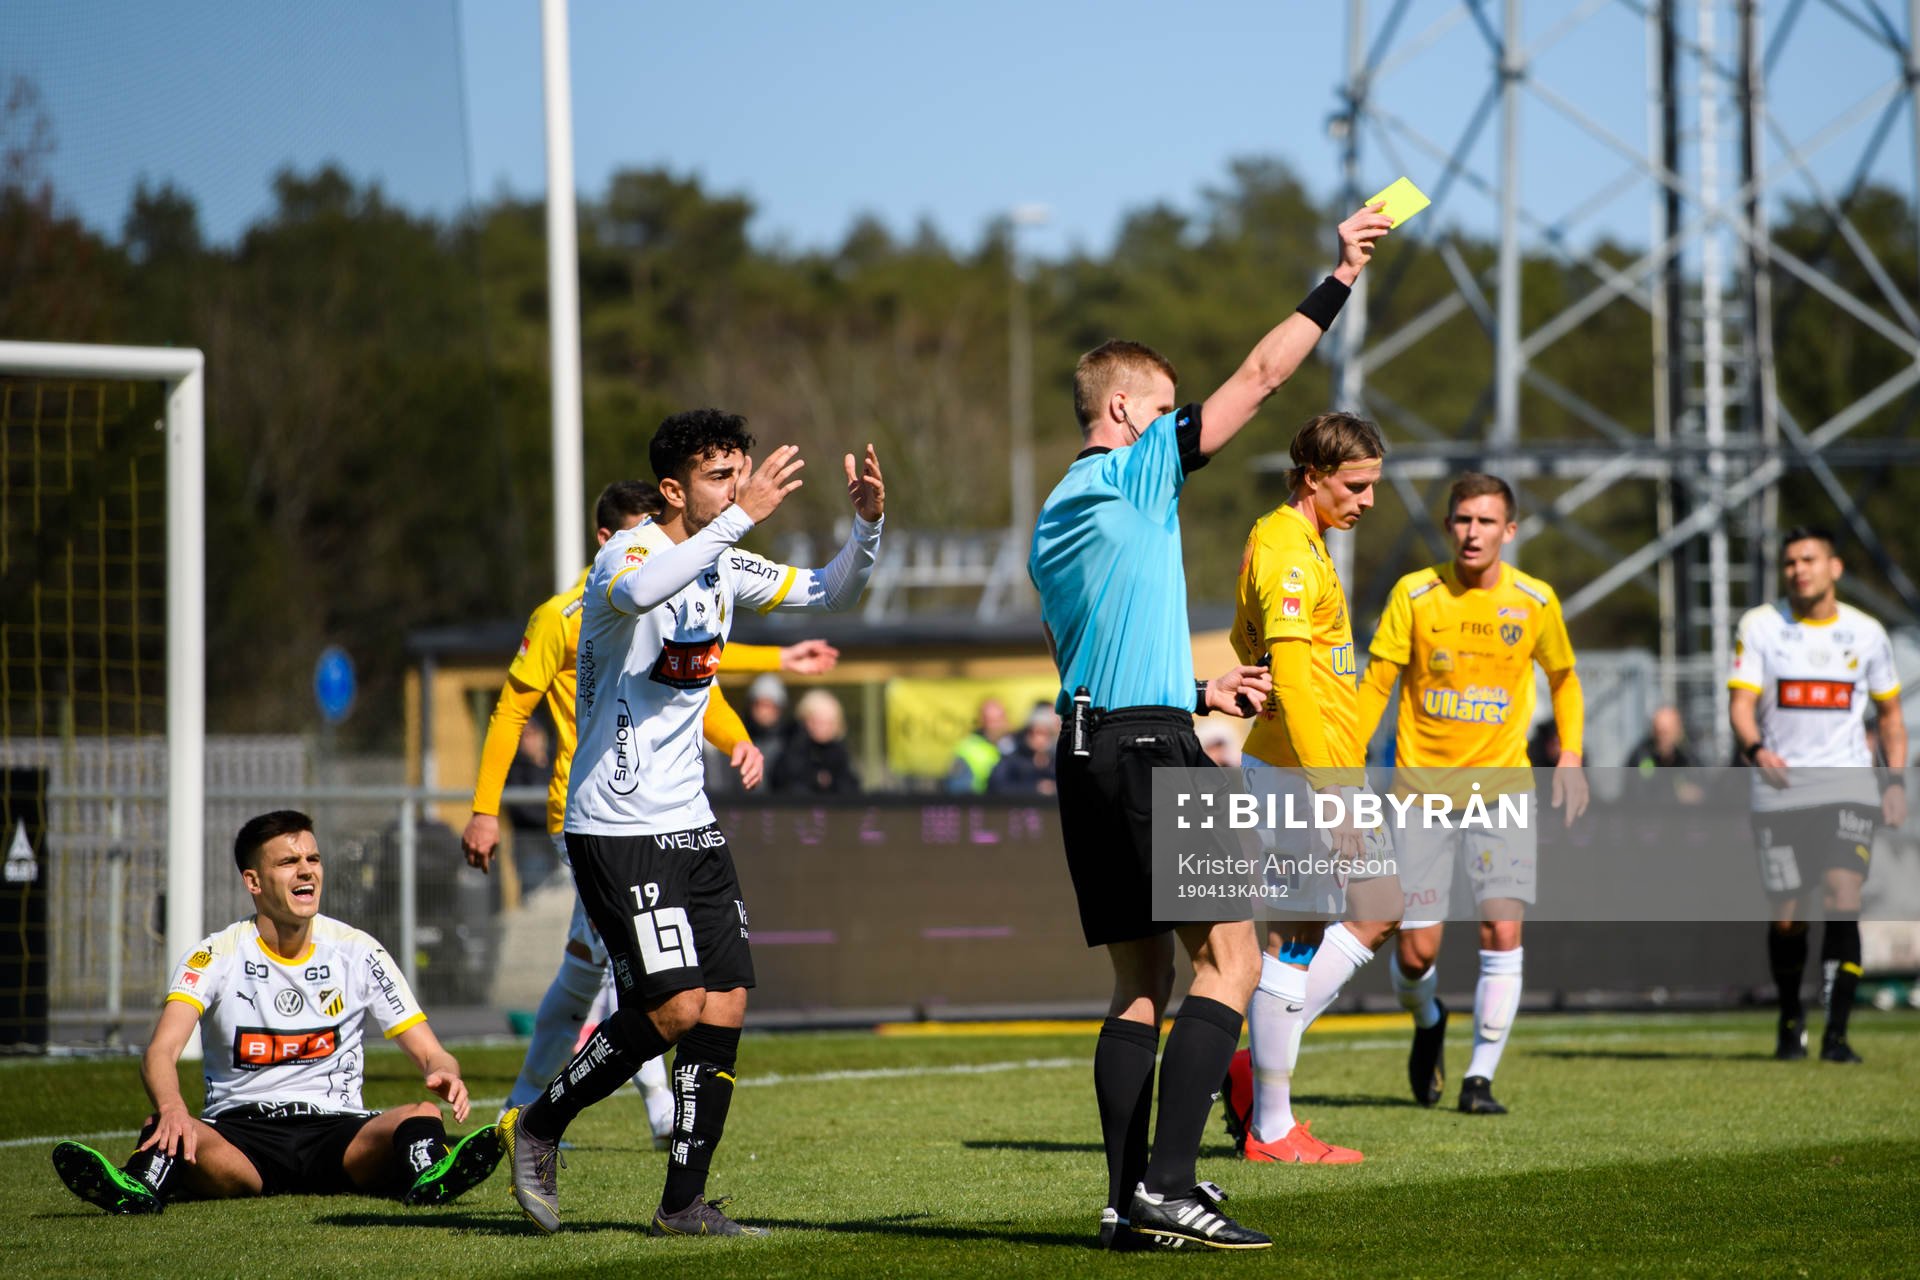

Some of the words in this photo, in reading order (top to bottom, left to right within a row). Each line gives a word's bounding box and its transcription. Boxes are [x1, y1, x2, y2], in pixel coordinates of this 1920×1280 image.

[1461, 621, 1494, 636] FBG
[668, 653, 720, 671] BRA
[1785, 686, 1850, 704] BRA
[614, 714, 629, 781] BOHUS
[630, 882, 660, 910] 19
[365, 953, 406, 1015] stadium
[248, 1037, 331, 1058] BRA
